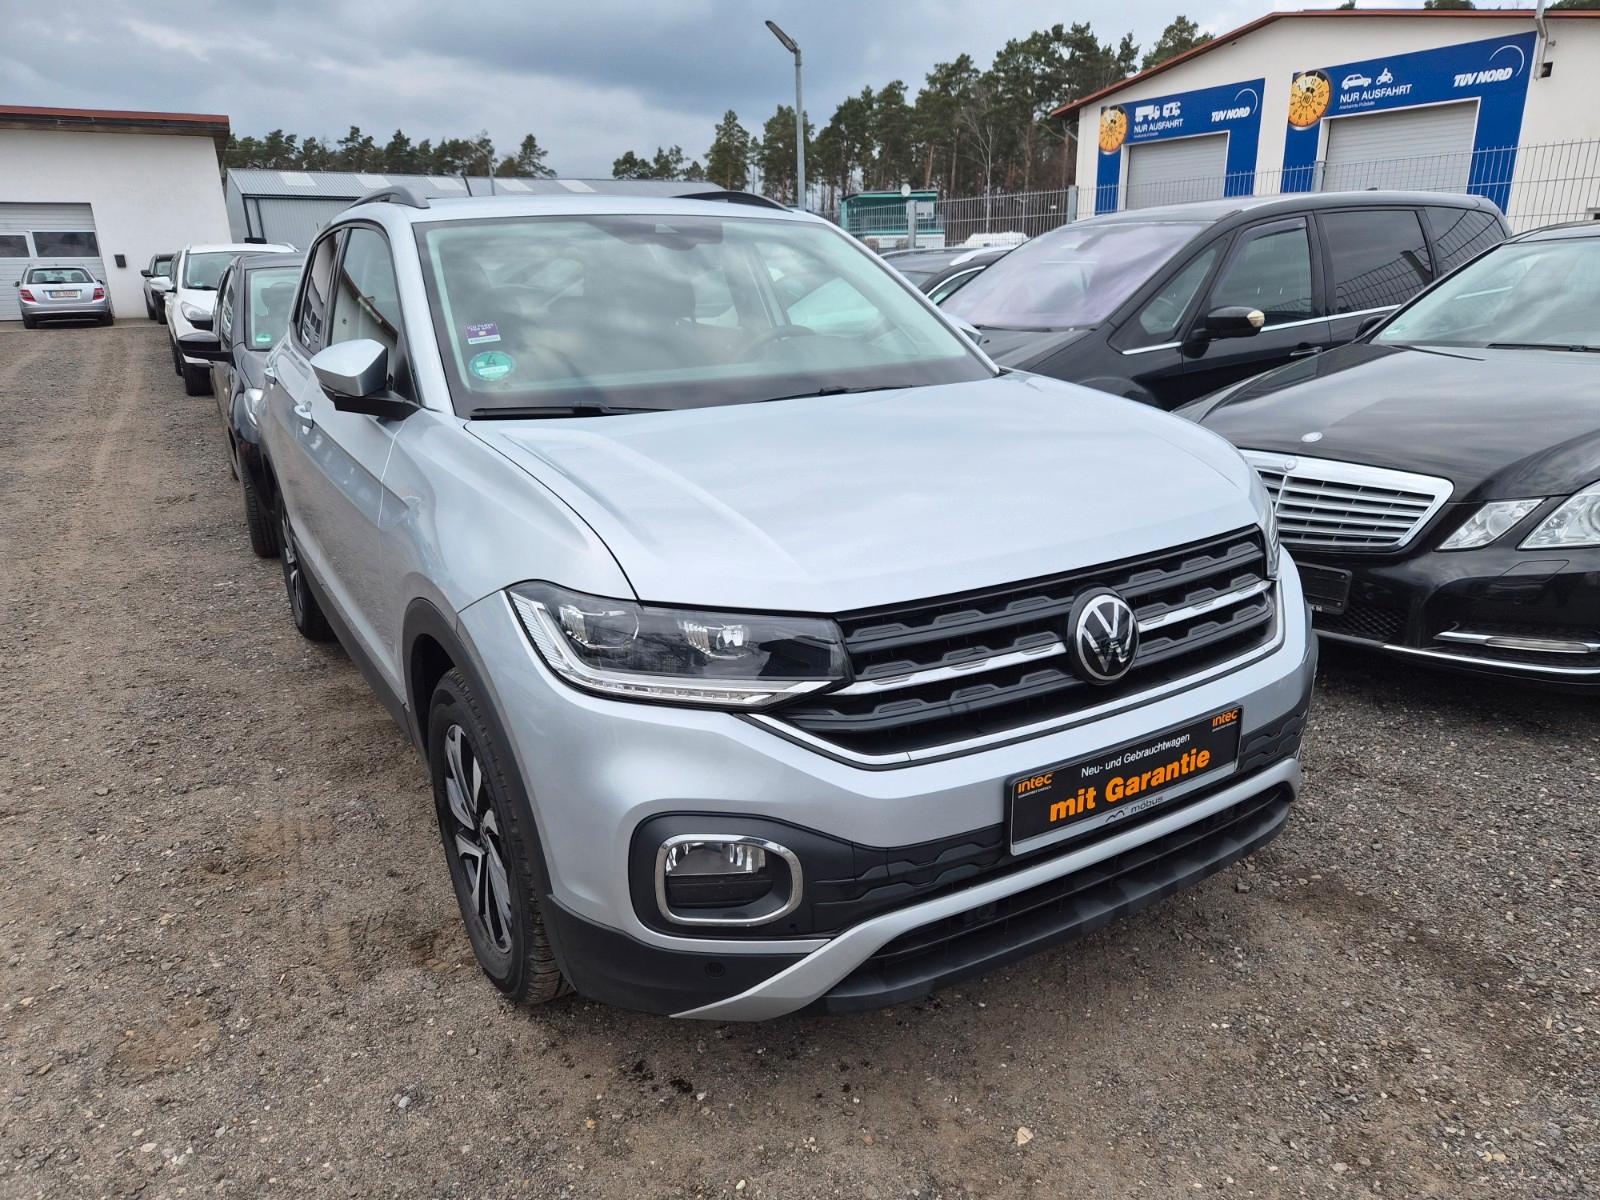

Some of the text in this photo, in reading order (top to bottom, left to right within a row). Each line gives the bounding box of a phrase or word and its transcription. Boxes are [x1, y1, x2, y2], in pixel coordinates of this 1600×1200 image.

[1476, 67, 1513, 84] NORD
[1340, 84, 1412, 103] NUR AUSFAHRT
[1226, 106, 1251, 121] NORD
[1133, 118, 1184, 134] NUR AUSFAHRT
[1212, 709, 1239, 727] intec
[1081, 733, 1190, 778] Neu- und Gebrauchtwagen
[1017, 773, 1054, 794] intec
[1049, 748, 1211, 822] mit Garantie
